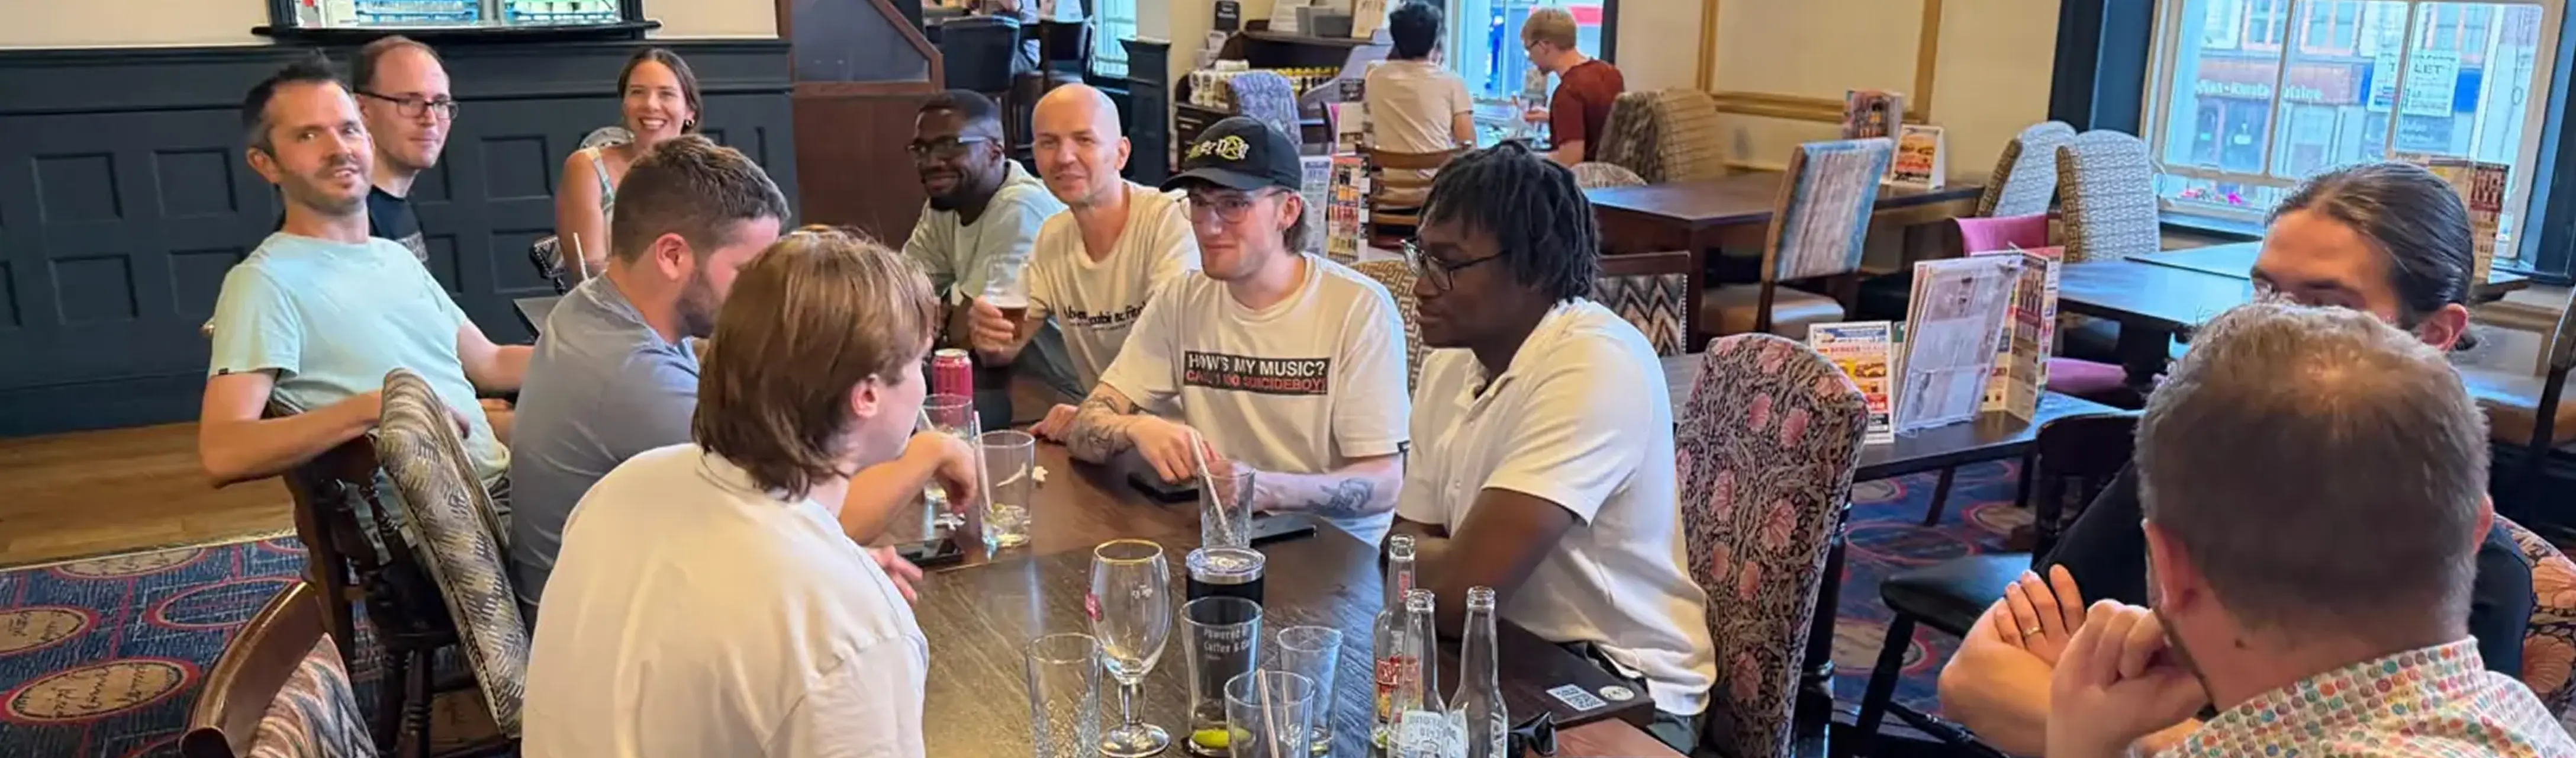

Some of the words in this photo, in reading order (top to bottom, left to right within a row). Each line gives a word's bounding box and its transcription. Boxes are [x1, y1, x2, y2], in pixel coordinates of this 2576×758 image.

[2414, 64, 2442, 74] LET
[1234, 358, 1255, 374] MY
[1260, 361, 1325, 377] MUSIC?
